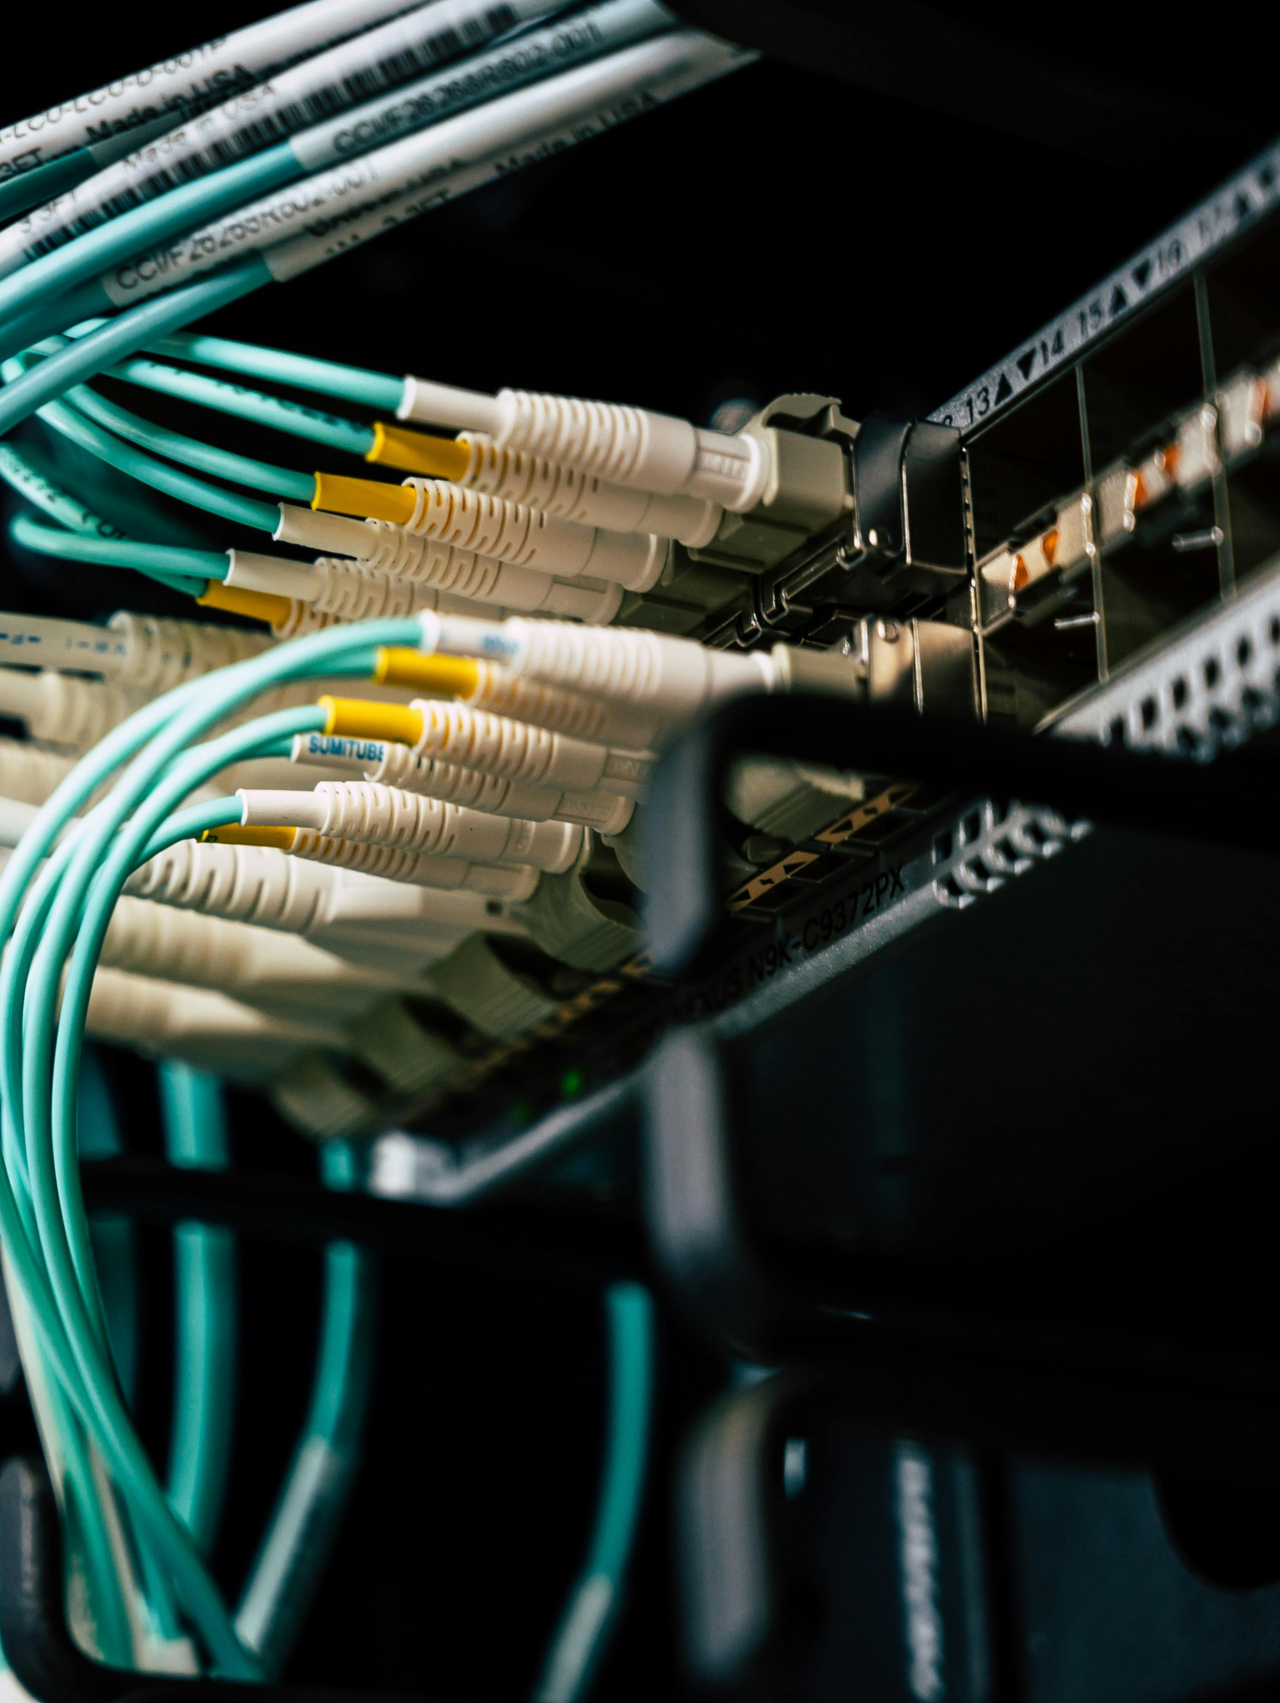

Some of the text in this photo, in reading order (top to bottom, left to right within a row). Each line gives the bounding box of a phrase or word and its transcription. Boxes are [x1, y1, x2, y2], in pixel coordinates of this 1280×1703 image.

[965, 386, 991, 425] 13
[1039, 328, 1065, 367] 14
[309, 733, 385, 764] SUMITUBE
[748, 861, 907, 987] N9K-C9372PX
